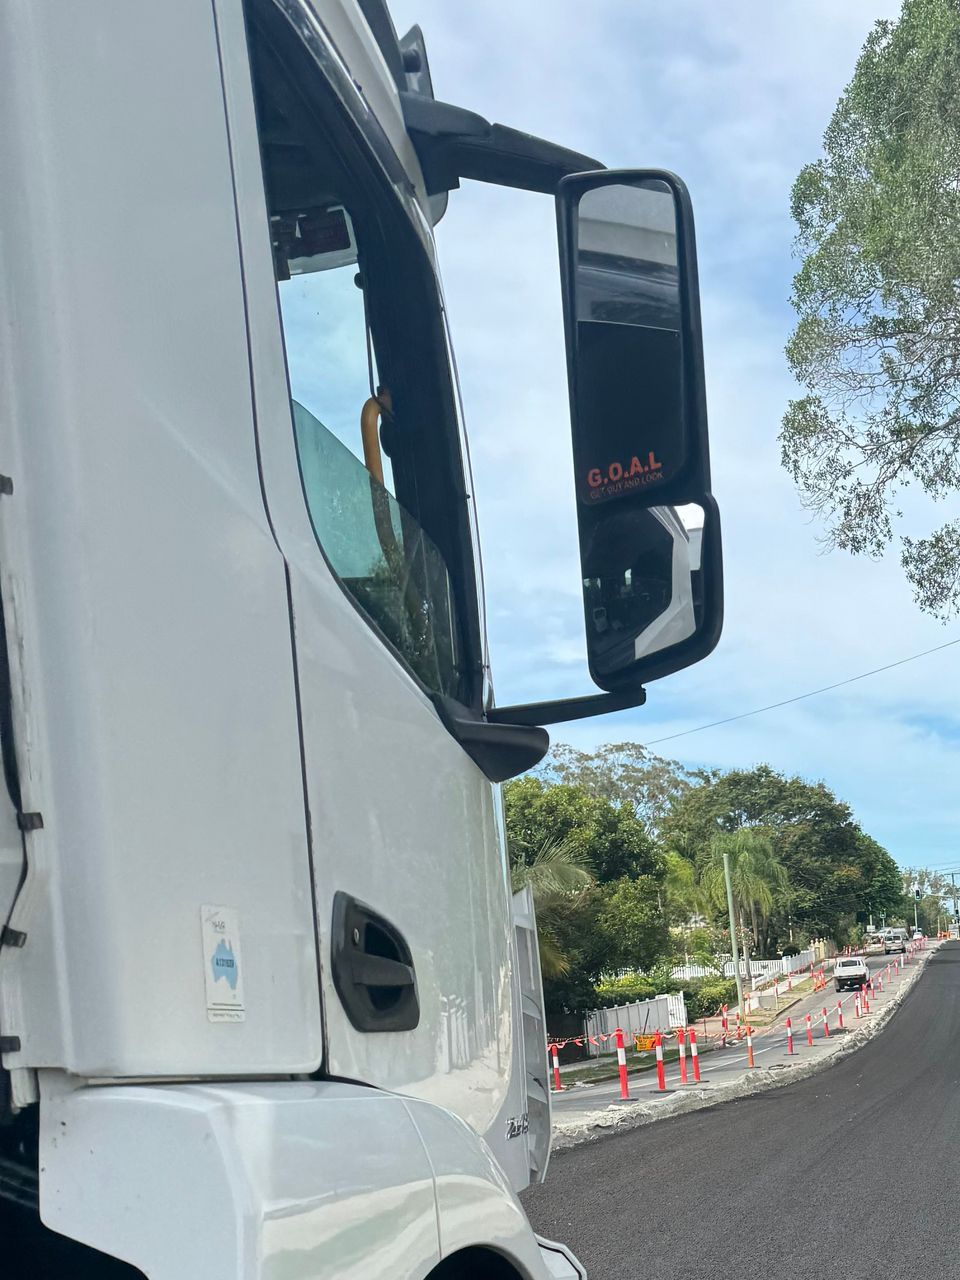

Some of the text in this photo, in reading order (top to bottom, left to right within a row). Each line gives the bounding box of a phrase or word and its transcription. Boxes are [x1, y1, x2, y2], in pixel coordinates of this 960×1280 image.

[587, 451, 662, 488] G.O.A.L
[624, 477, 641, 489] AND
[641, 472, 664, 485] LOOK
